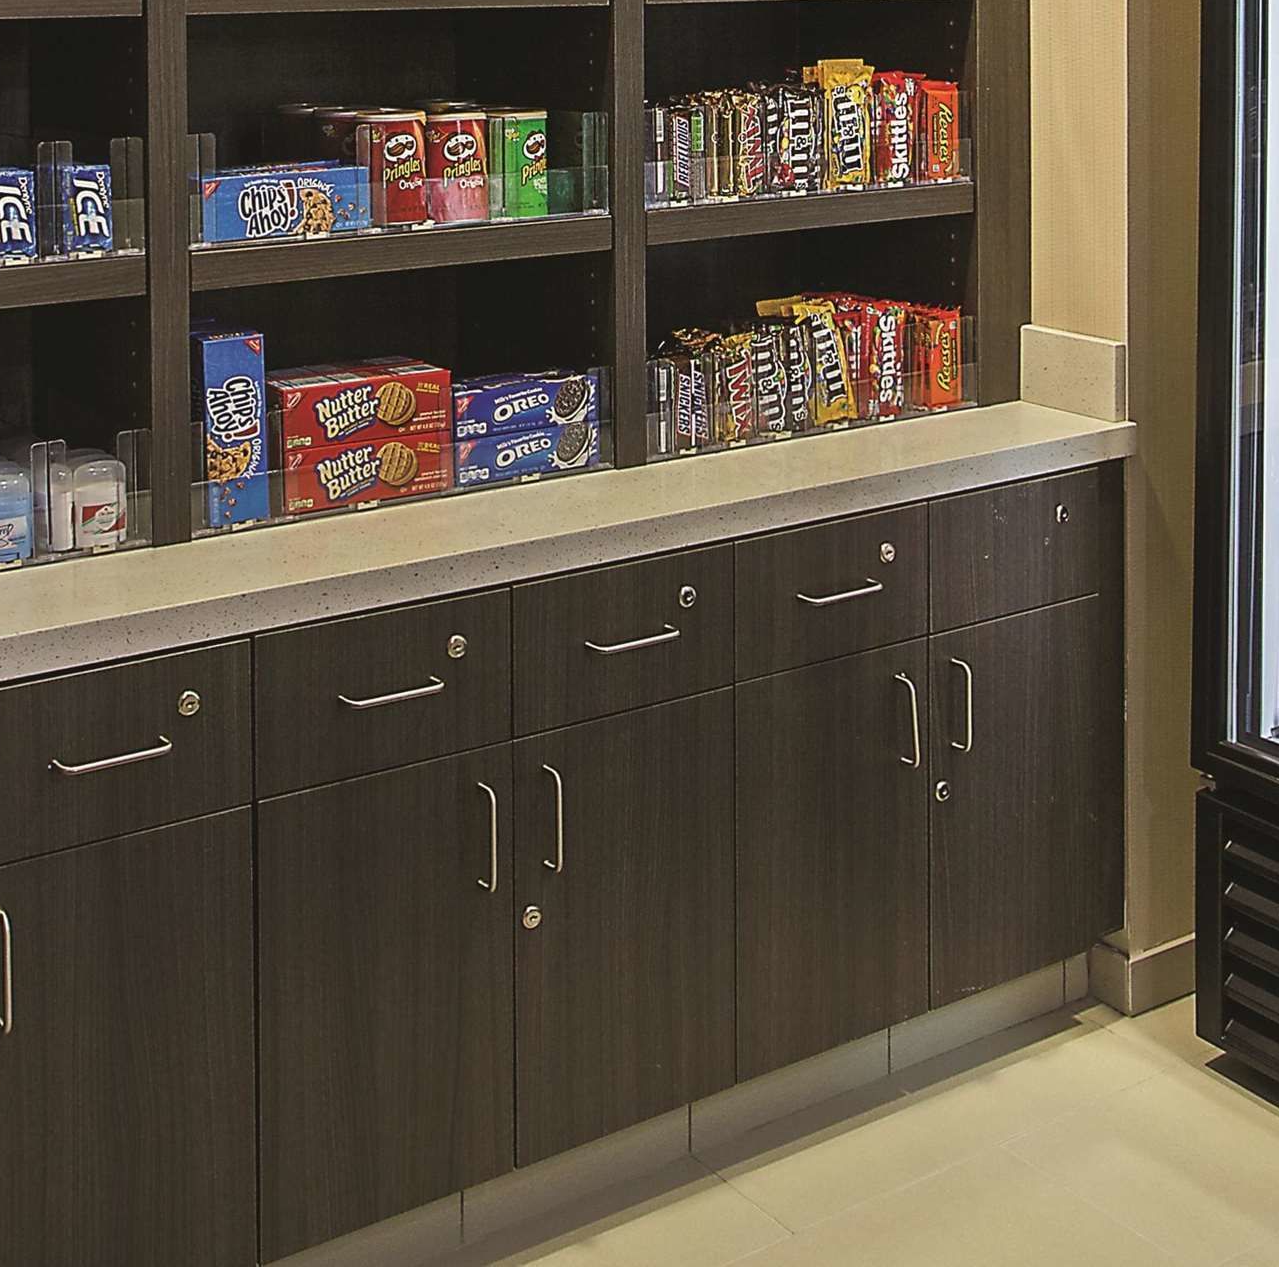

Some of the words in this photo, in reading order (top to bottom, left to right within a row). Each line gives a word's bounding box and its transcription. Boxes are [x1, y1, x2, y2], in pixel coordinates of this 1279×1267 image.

[383, 158, 421, 183] Pringles
[443, 157, 482, 188] Pringles
[73, 179, 110, 237] ICE
[239, 184, 287, 218] Chips
[224, 376, 255, 430] Chips
[315, 385, 372, 423] Nutter
[324, 399, 379, 438] Butter
[493, 393, 550, 423] OREO
[678, 375, 691, 436] SNICKERS
[317, 446, 373, 485] Nutter
[495, 438, 552, 468] OREO
[326, 459, 381, 500] Butter
